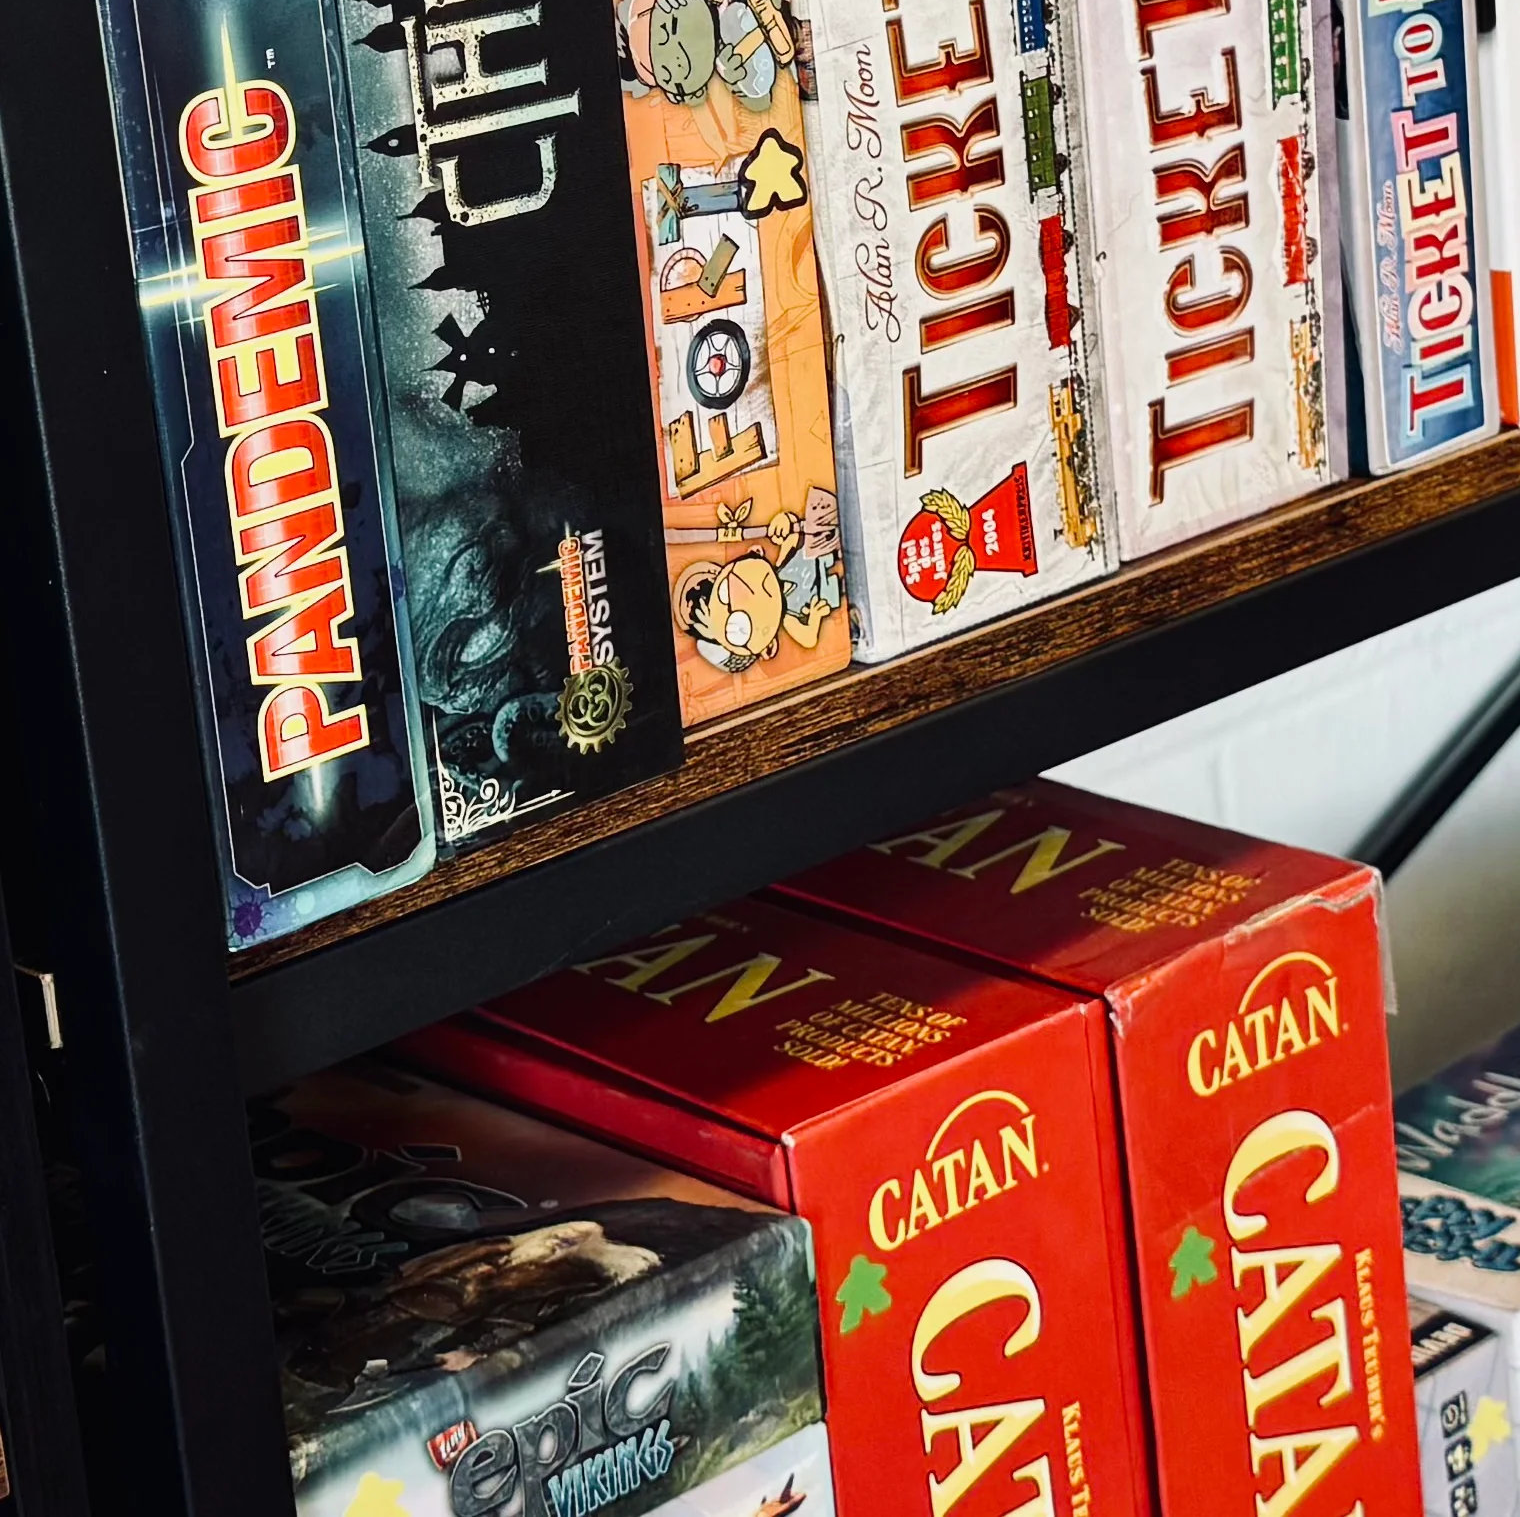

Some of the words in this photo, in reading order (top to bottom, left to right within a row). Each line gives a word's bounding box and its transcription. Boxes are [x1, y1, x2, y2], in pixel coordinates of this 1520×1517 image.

[846, 42, 872, 150] Moon
[1395, 12, 1446, 106] TO
[866, 242, 901, 342] Alan
[1391, 110, 1476, 446] TICKET
[179, 79, 369, 783] PANDEMIC
[901, 539, 920, 584] Spiel
[918, 536, 931, 568] des
[931, 521, 947, 580] Jahres
[982, 509, 1000, 555] 2004
[580, 530, 616, 664] SYSTEM
[1187, 978, 1339, 1097] CATAN
[868, 1115, 1037, 1252] CATAN
